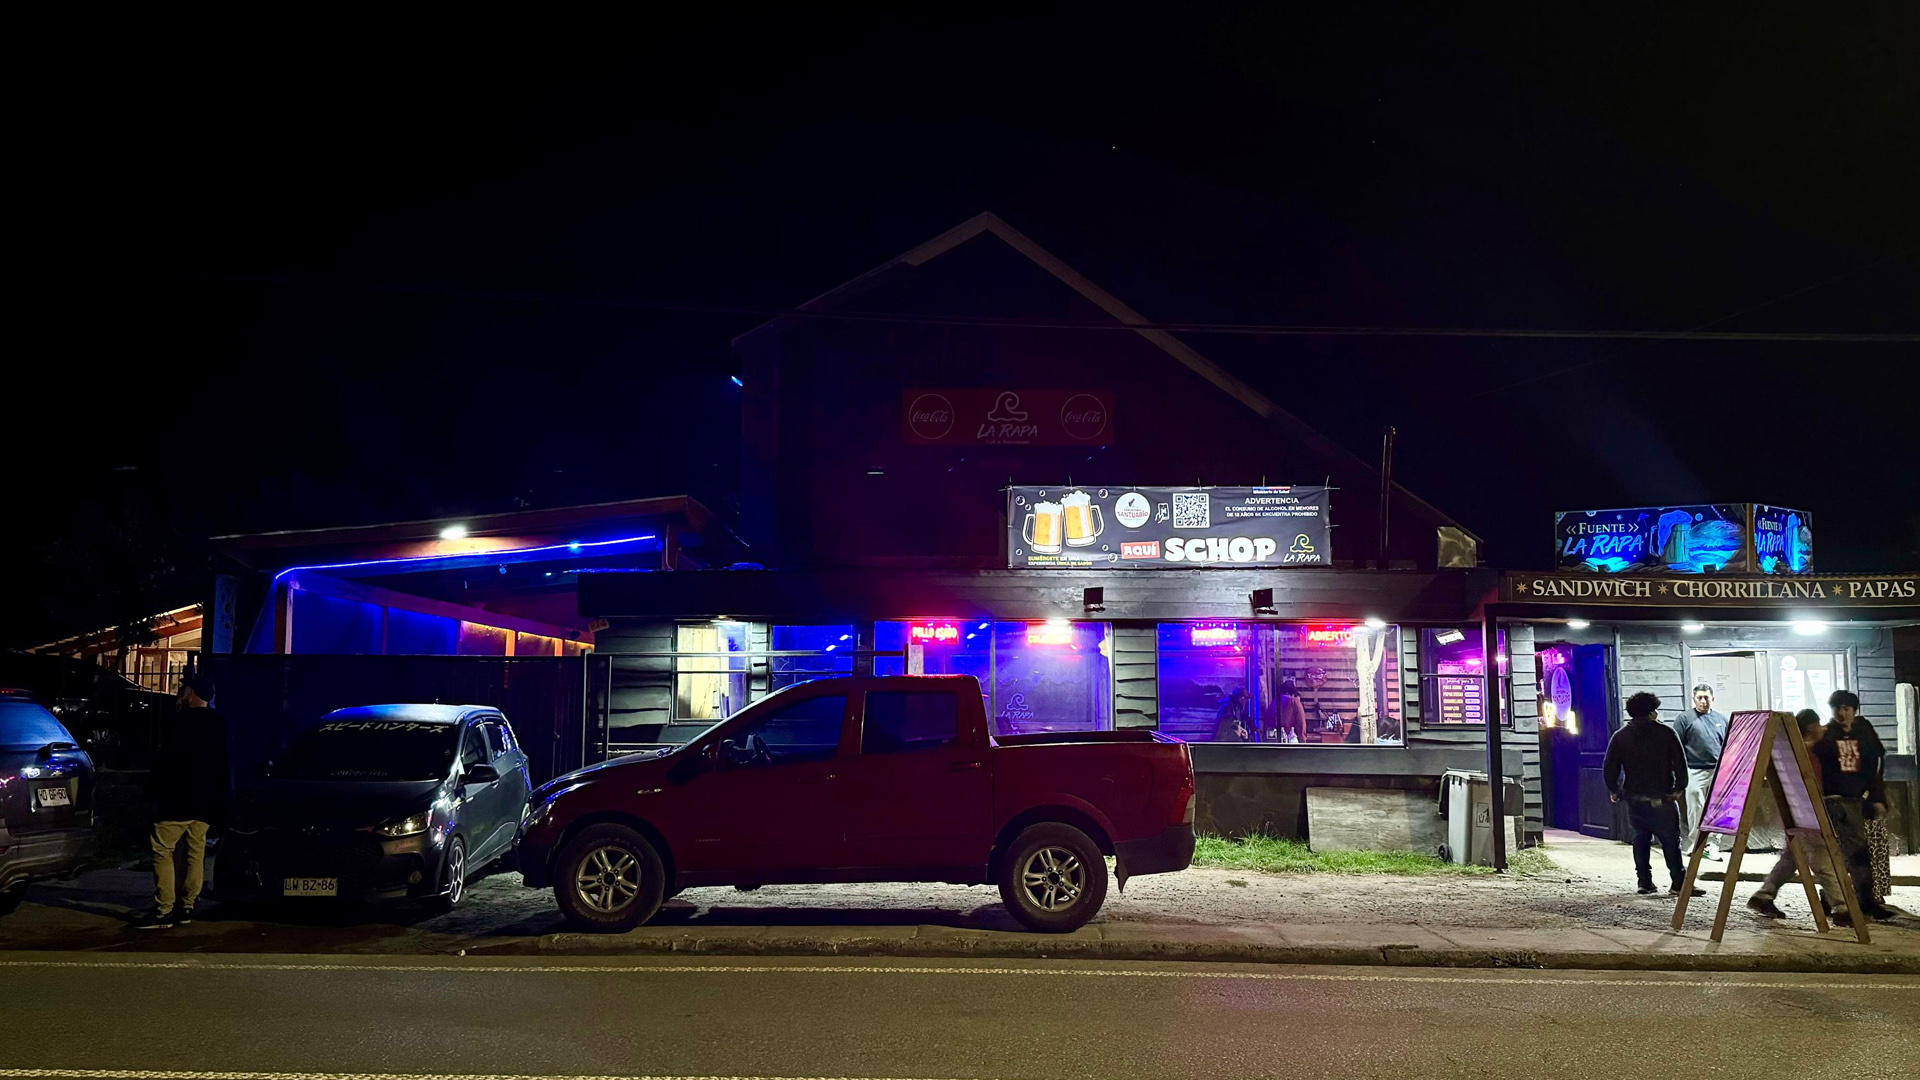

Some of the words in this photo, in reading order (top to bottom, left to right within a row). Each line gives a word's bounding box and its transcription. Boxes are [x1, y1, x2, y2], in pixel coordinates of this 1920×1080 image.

[976, 423, 995, 439] LA
[998, 423, 1038, 438] RAPA
[1244, 497, 1300, 505] ADVERTENCIA
[1123, 544, 1157, 556] AQUÍ
[1164, 536, 1277, 562] SCHOP
[1562, 536, 1588, 557] LA
[1589, 534, 1643, 556] RAPA
[1757, 531, 1766, 555] LA
[1766, 531, 1785, 553] RAPA
[1283, 553, 1295, 563] LA
[1296, 553, 1321, 563] RAPA
[1532, 579, 1652, 597] SANDWICH
[1673, 581, 1827, 598] CHORRILLANA
[1848, 580, 1916, 598] PAPAS
[1308, 630, 1353, 641] ABIERTO
